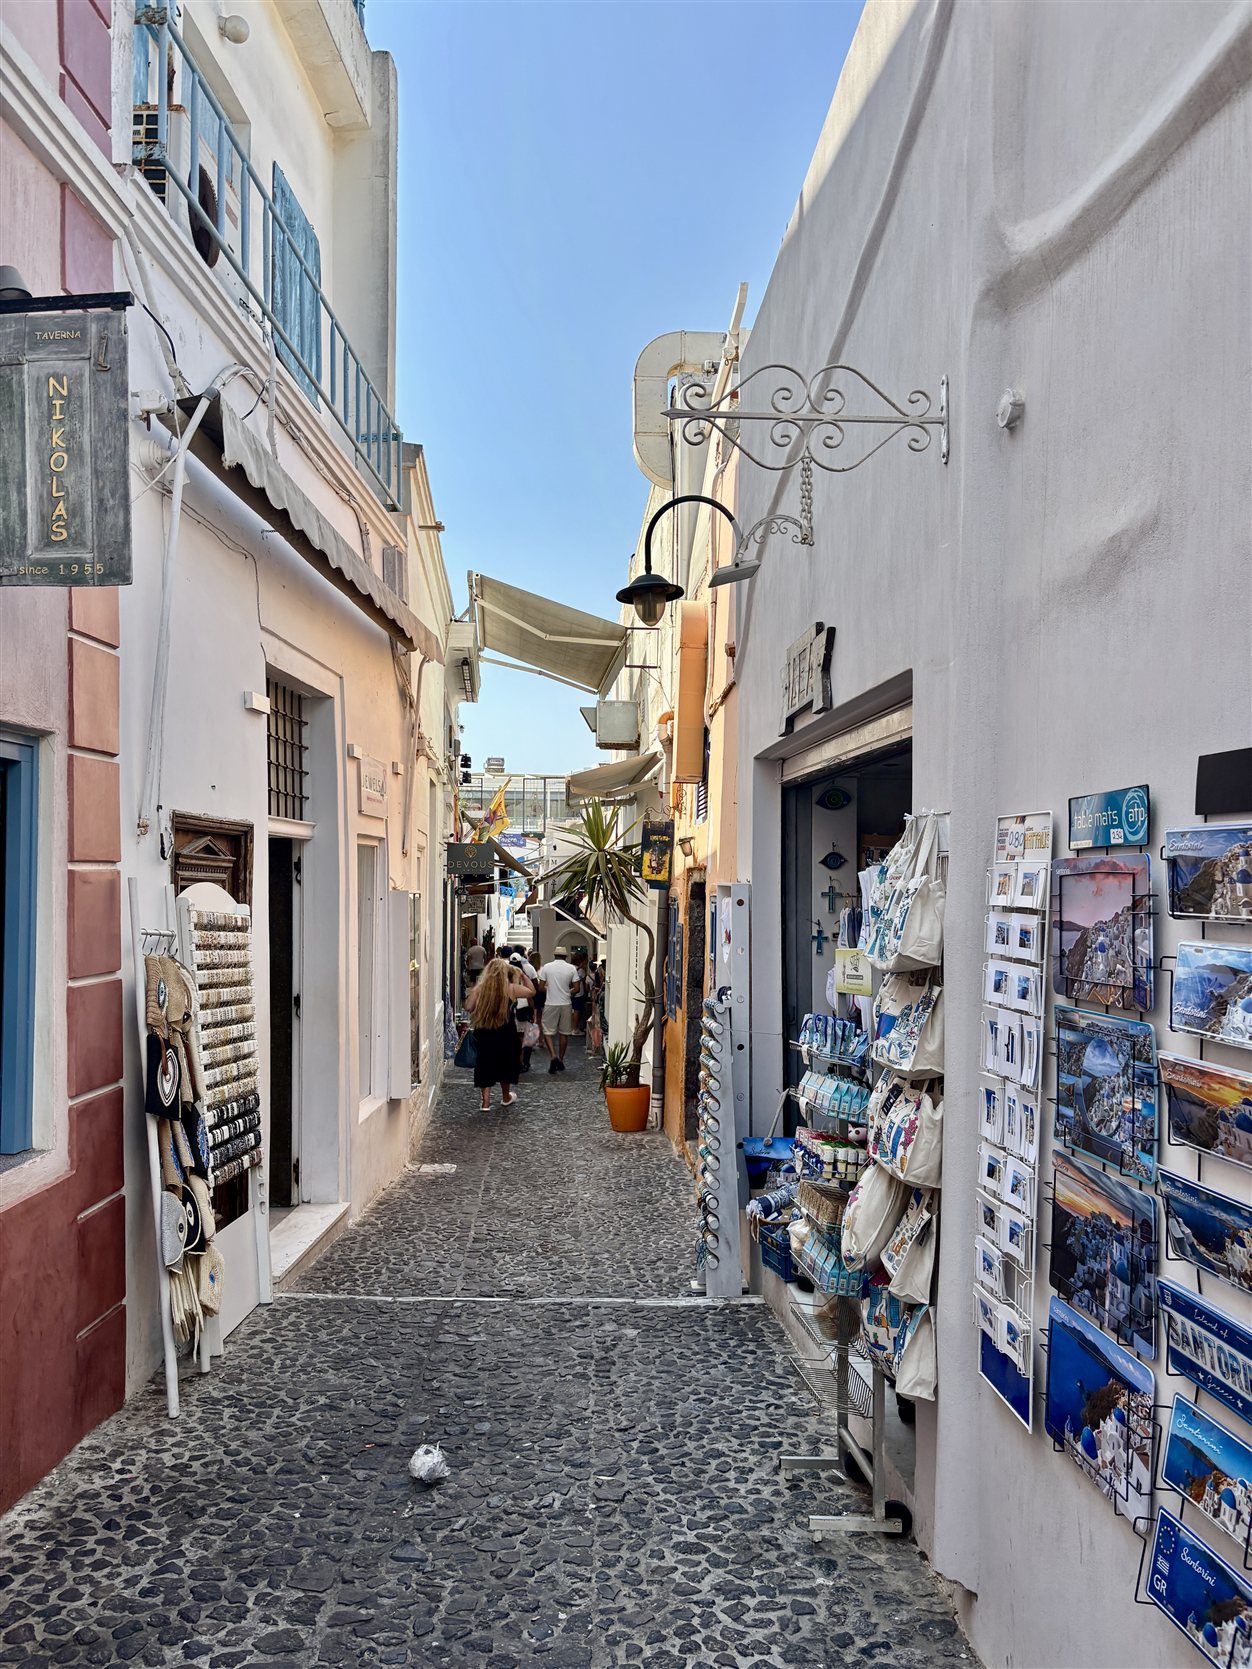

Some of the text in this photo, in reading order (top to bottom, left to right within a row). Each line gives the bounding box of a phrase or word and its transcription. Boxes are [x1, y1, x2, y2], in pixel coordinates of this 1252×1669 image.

[34, 330, 82, 341] TAVERNA
[48, 375, 69, 542] NIKOLAS
[19, 563, 104, 576] since 1955
[1074, 806, 1119, 829] table mats
[1128, 803, 1145, 826] atp
[1169, 1313, 1252, 1397] SANTORI
[1176, 1414, 1223, 1455] Santorini
[1181, 1546, 1217, 1587] Santorini
[1153, 1574, 1167, 1597] GR
